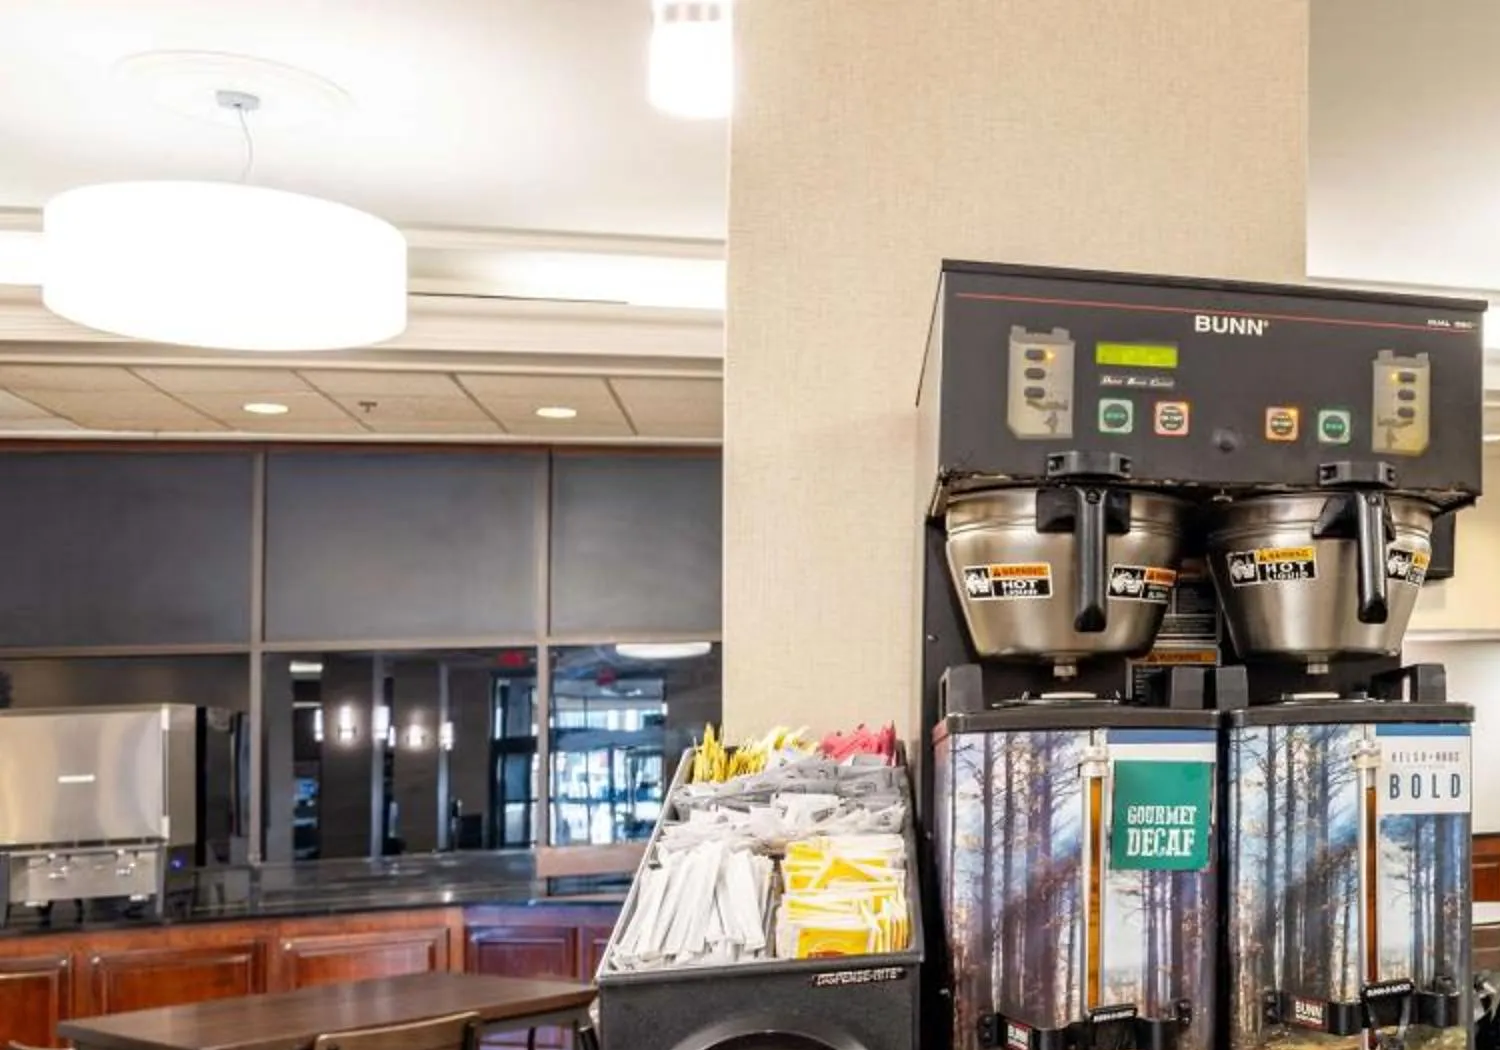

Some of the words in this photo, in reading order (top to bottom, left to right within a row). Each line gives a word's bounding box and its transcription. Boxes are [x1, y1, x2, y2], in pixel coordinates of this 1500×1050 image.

[1195, 315, 1263, 336] BUNN
[1266, 562, 1307, 572] HOT
[1002, 579, 1038, 589] HOT
[1389, 772, 1461, 800] BOLD
[1127, 805, 1197, 825] GOURMET
[1126, 827, 1196, 857] DECAF
